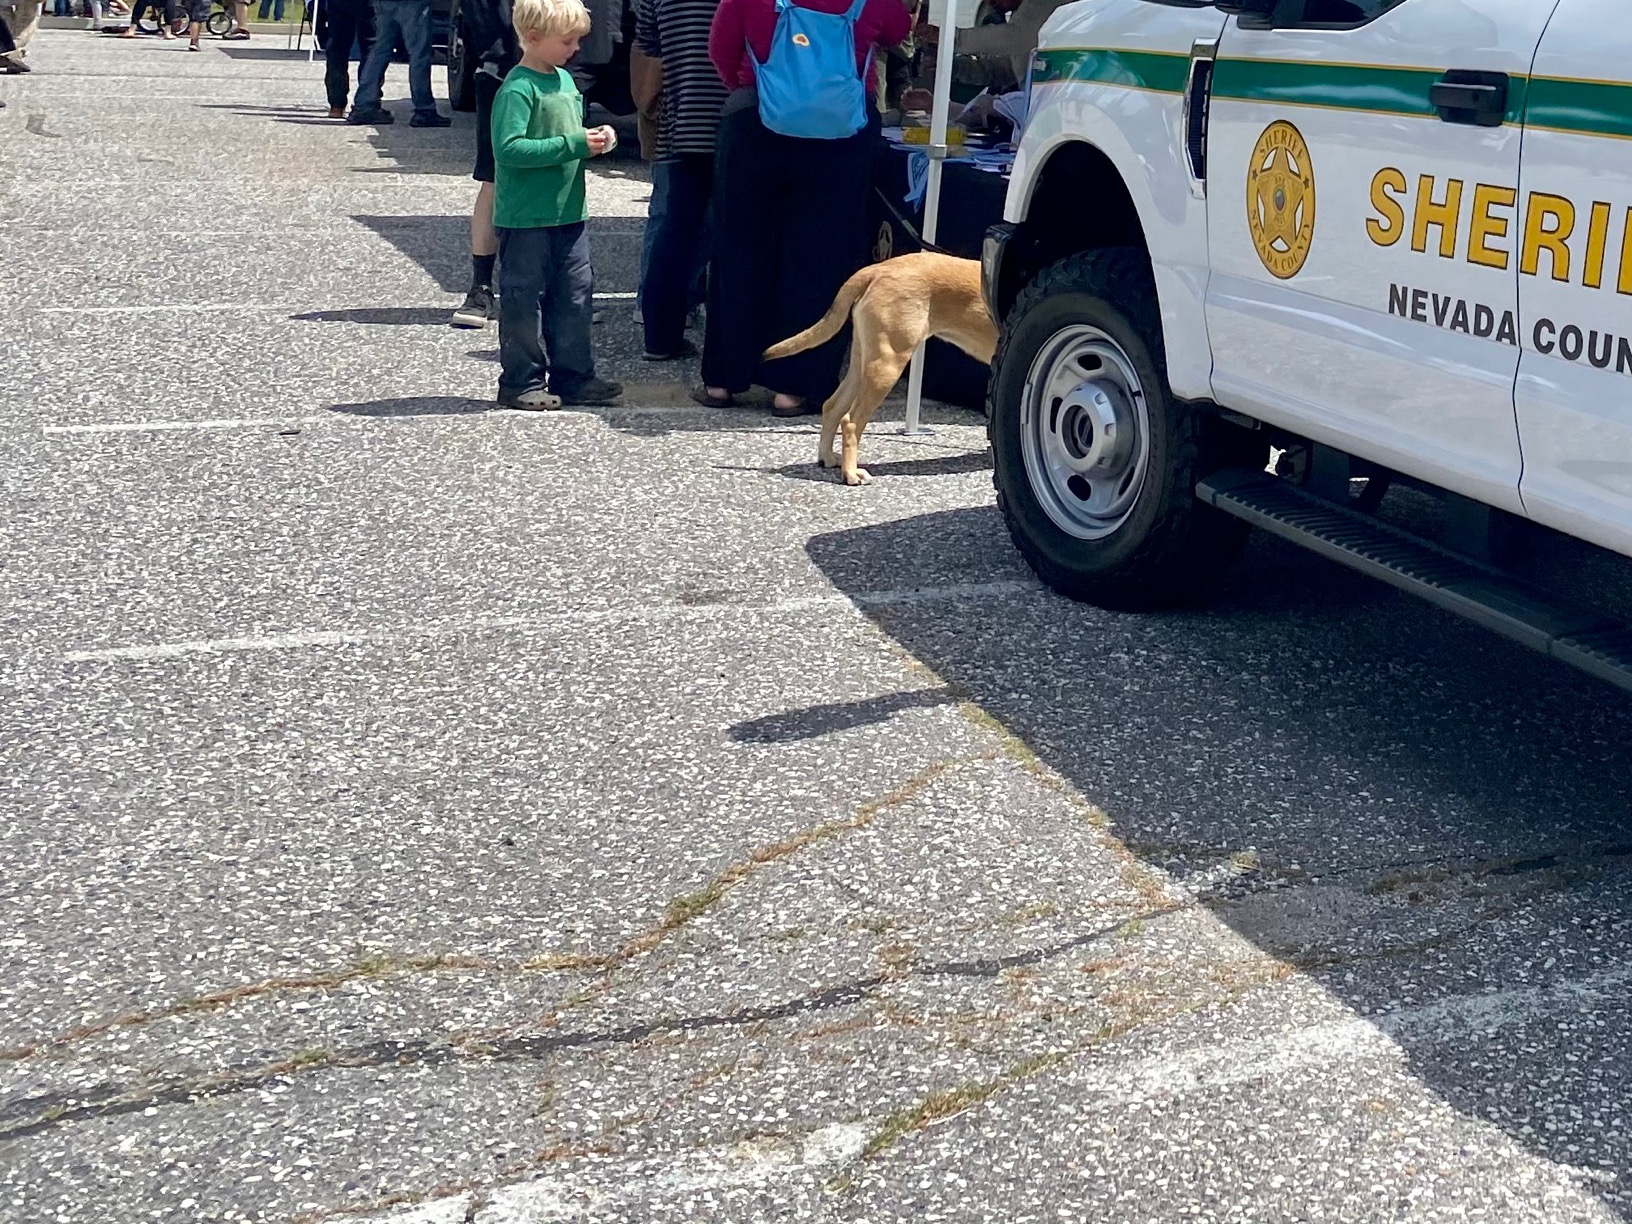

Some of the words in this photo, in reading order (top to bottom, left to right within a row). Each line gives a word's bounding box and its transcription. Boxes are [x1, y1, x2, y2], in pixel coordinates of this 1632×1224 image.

[1259, 129, 1307, 159] SHERIFF
[1251, 209, 1279, 270] NEVADA
[1280, 223, 1310, 272] COUNTY
[1388, 284, 1518, 346] NEVADA
